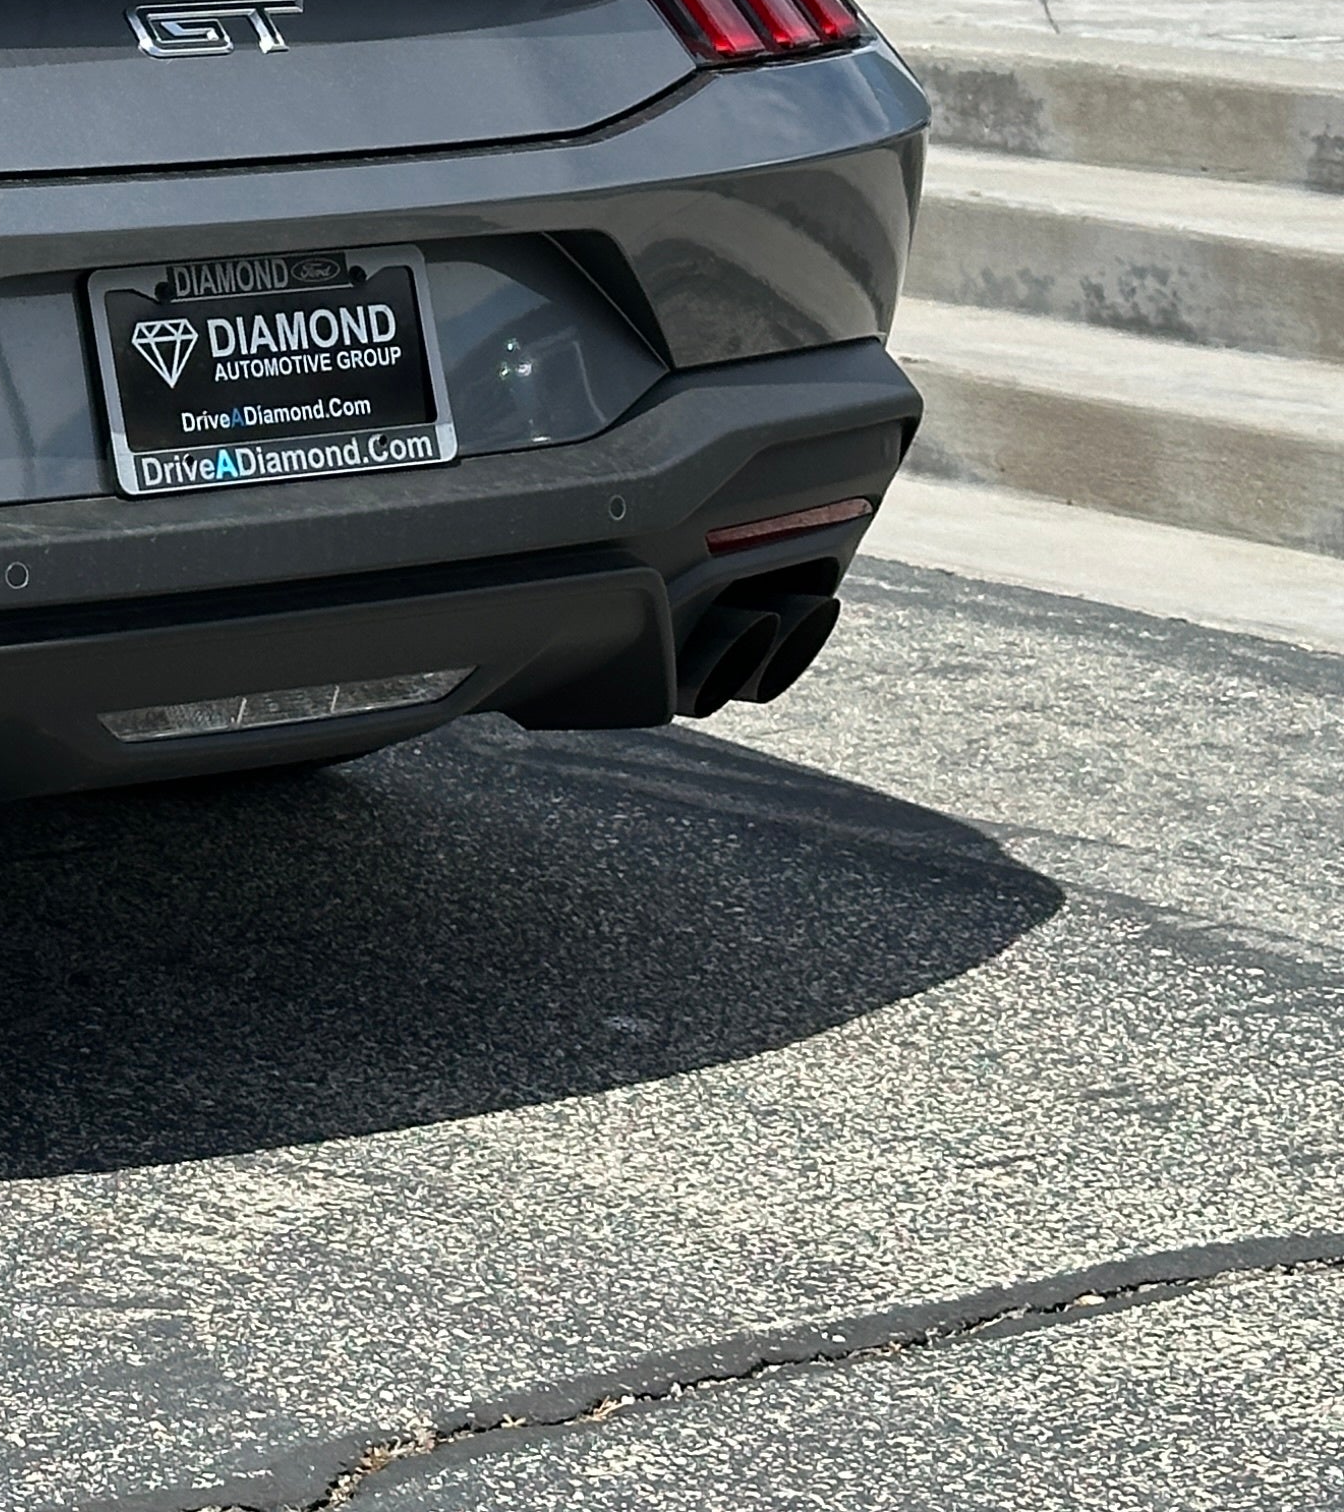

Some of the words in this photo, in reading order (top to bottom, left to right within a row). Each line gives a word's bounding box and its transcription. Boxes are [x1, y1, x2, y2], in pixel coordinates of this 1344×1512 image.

[173, 259, 289, 297] DIAMOND
[206, 304, 396, 357] DIAMOND
[214, 354, 332, 382] AUTOMOTIVE
[337, 346, 401, 370] GROUP
[181, 398, 371, 433] DriveADiamond.Com
[141, 434, 433, 487] DriveADiamond.Com
